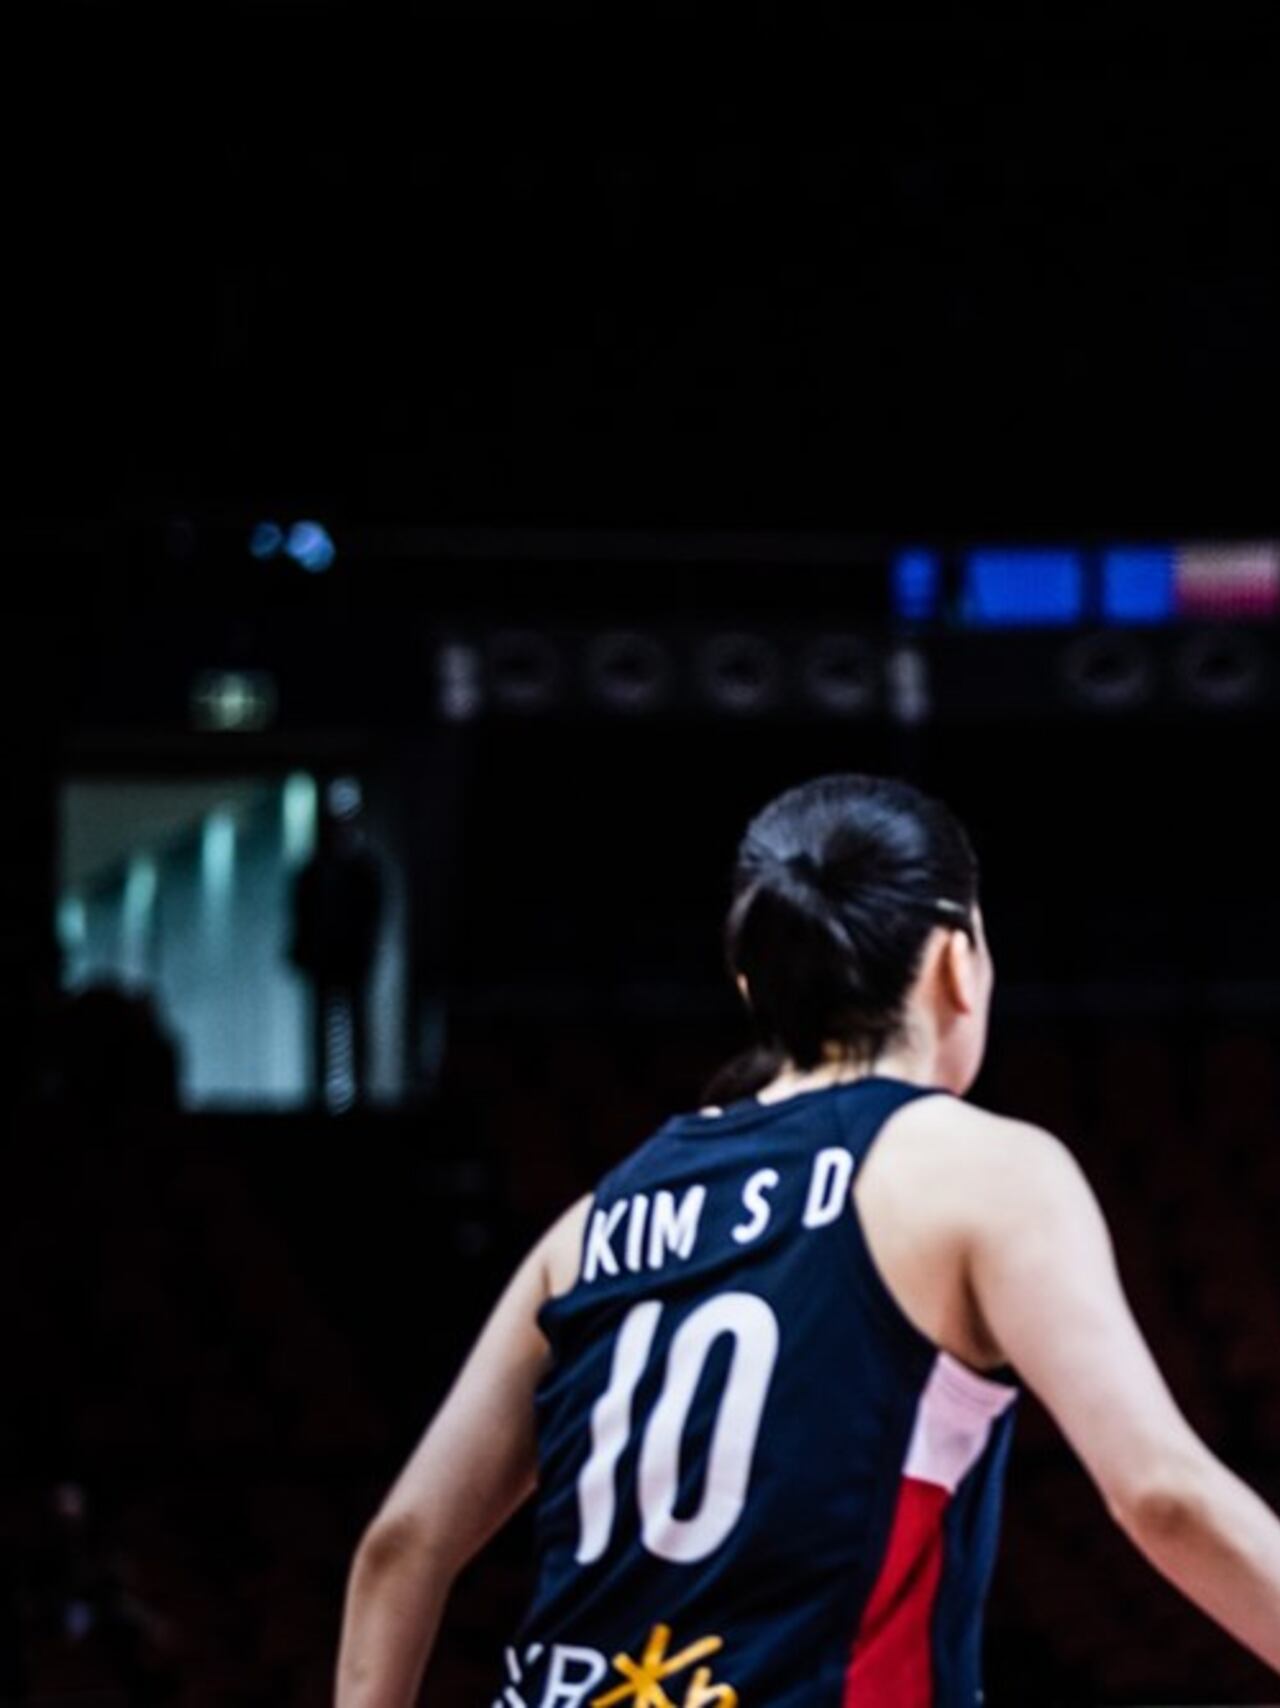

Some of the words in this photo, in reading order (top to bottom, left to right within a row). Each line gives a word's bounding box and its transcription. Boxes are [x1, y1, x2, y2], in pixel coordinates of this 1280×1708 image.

[581, 1182, 707, 1283] KIM
[730, 1166, 780, 1245] S
[802, 1145, 854, 1230] D
[573, 1289, 781, 1567] 10
